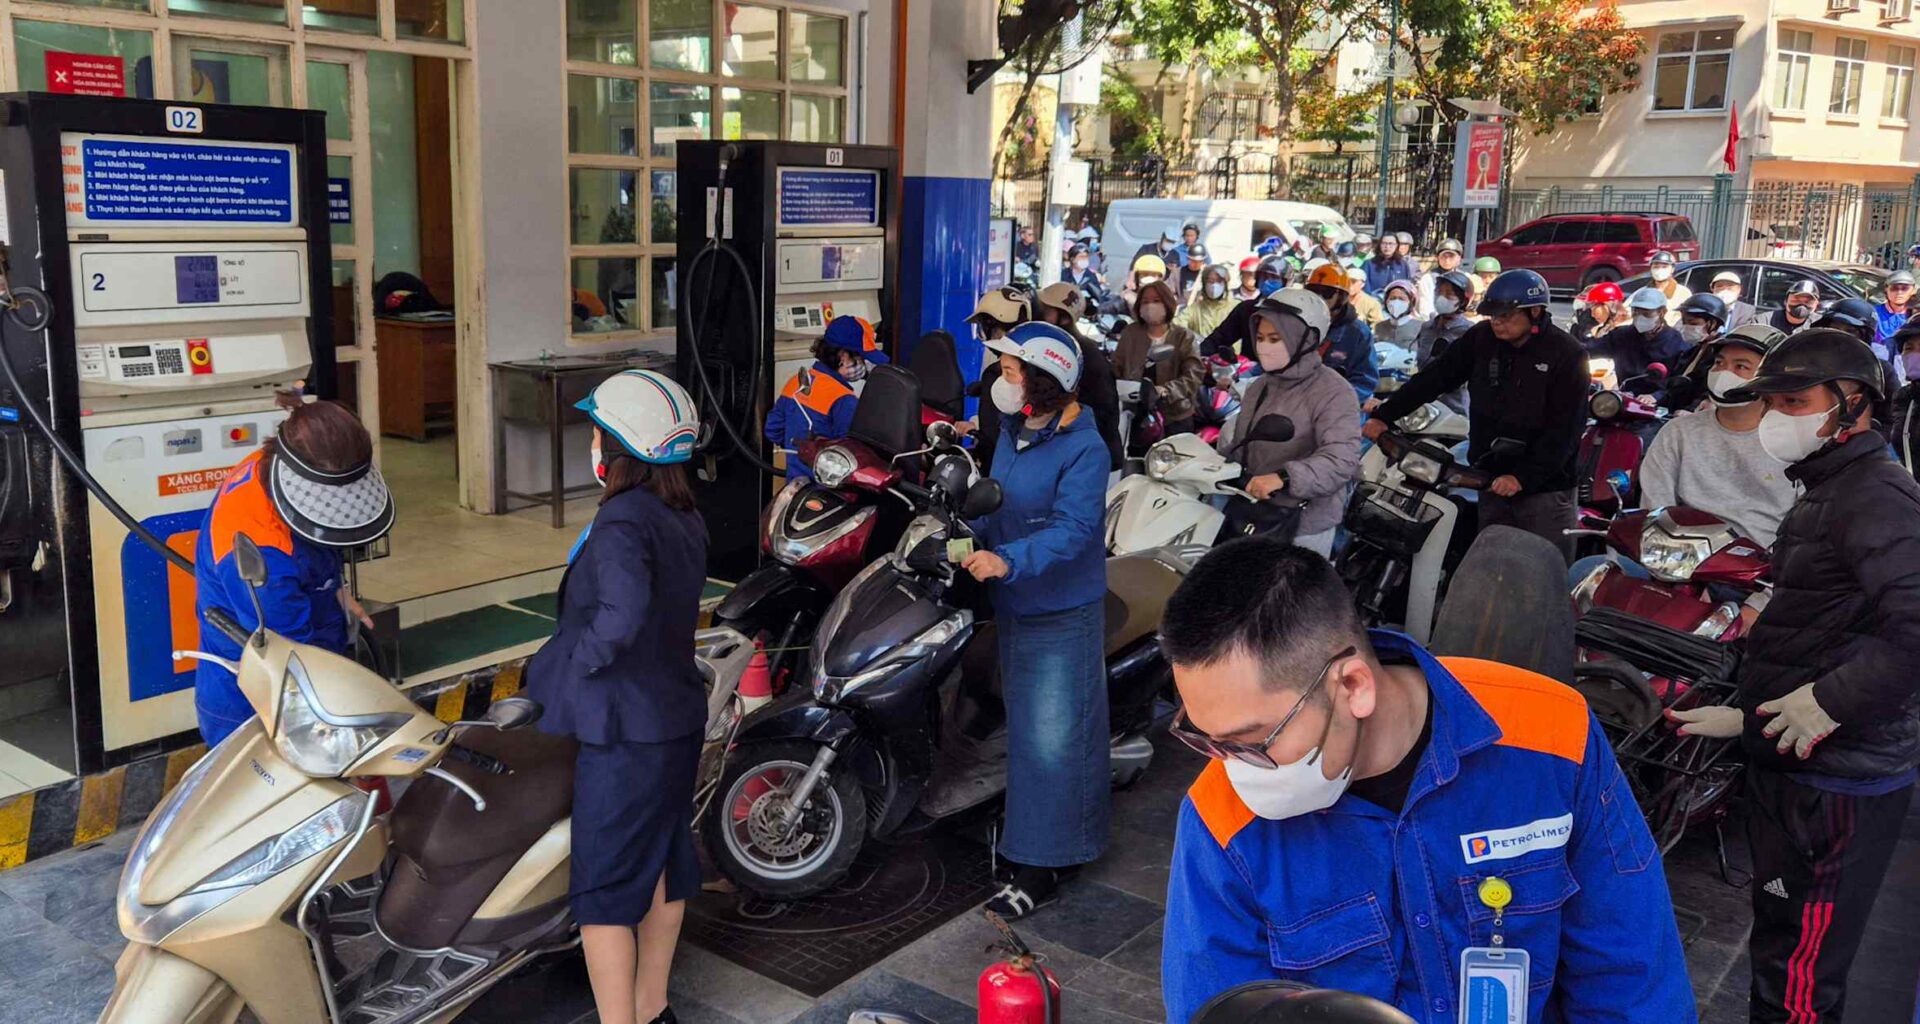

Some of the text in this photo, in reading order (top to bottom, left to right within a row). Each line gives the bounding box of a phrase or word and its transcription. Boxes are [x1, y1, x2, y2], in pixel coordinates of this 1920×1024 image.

[172, 110, 197, 129] 02
[830, 150, 840, 163] 01
[785, 258, 790, 270] 1
[92, 273, 106, 291] 2
[168, 473, 202, 488] XĂNG
[1492, 825, 1570, 848] PETROLIMEX
